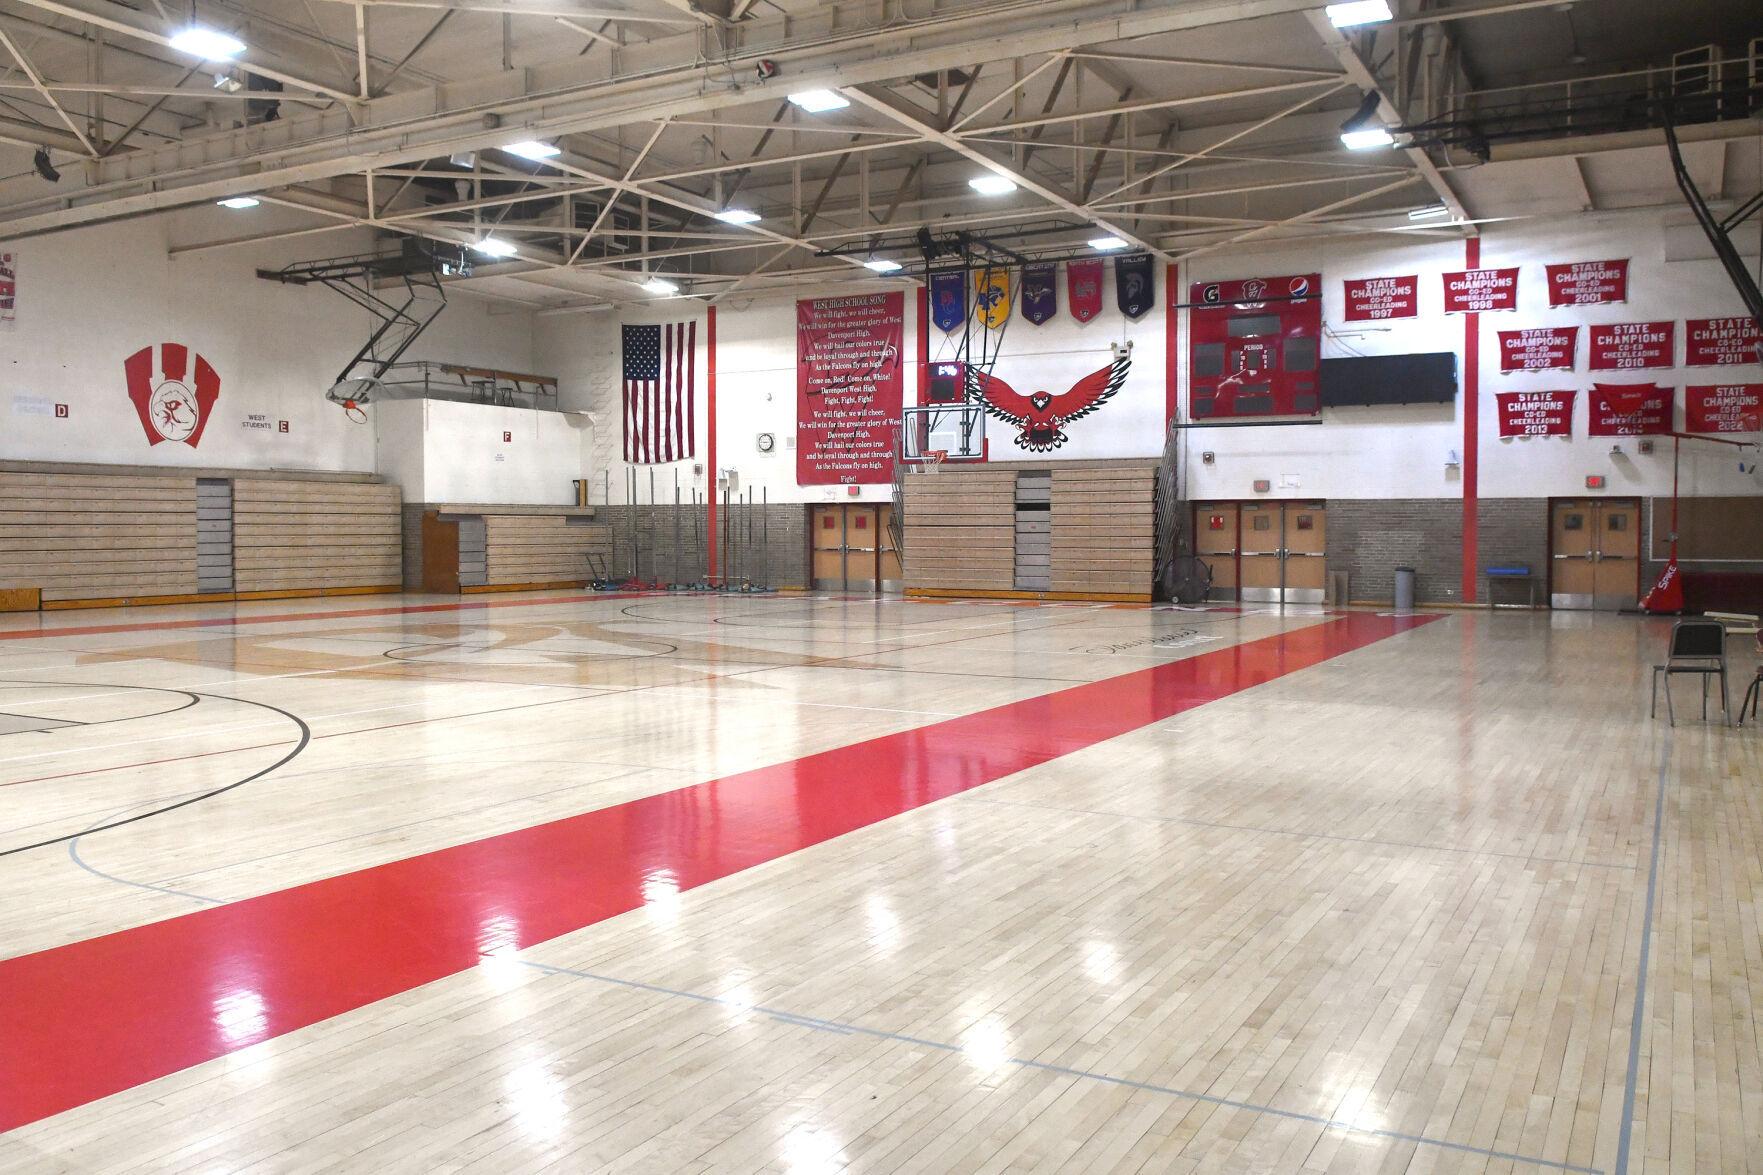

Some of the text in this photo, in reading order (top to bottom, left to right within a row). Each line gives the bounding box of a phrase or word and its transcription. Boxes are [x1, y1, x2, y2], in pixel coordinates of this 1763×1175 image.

[1572, 263, 1605, 272] STATE
[1465, 271, 1498, 280] STATE
[1556, 269, 1620, 283] CHAMPIONS
[1366, 279, 1396, 289] STATE
[1450, 278, 1512, 290] CHAMPIONS
[1352, 286, 1411, 298] CHAMPIONS
[1561, 285, 1615, 294] CHEERLEADING
[1455, 293, 1507, 302] CHEERLEADING
[1576, 294, 1601, 303] 2001
[813, 295, 886, 310] WEST HIGH SCHOOL SONG
[1356, 301, 1407, 310] CHEERLEADING
[1468, 300, 1492, 309] 1998
[1370, 309, 1392, 319] 1997
[1709, 319, 1751, 329] STATE
[1521, 329, 1553, 338] STATE
[1614, 325, 1649, 334] STATE
[1694, 328, 1763, 340] CHAMPION
[1506, 337, 1568, 348] CHAMPIONS
[1598, 333, 1666, 344] CHAMPIONS
[1512, 352, 1563, 360] CHEERLEADING
[1603, 350, 1660, 359] CHEERLEADING
[1718, 353, 1742, 363] 2011
[1524, 359, 1551, 367] 2002
[1617, 358, 1644, 367] 2010
[1717, 387, 1745, 396] STATE
[1519, 393, 1552, 401] STATE
[1704, 396, 1758, 406] CHAMPIONS
[58, 406, 66, 416] D
[1508, 402, 1563, 411] CHAMPIONS
[1525, 425, 1547, 434] 2013
